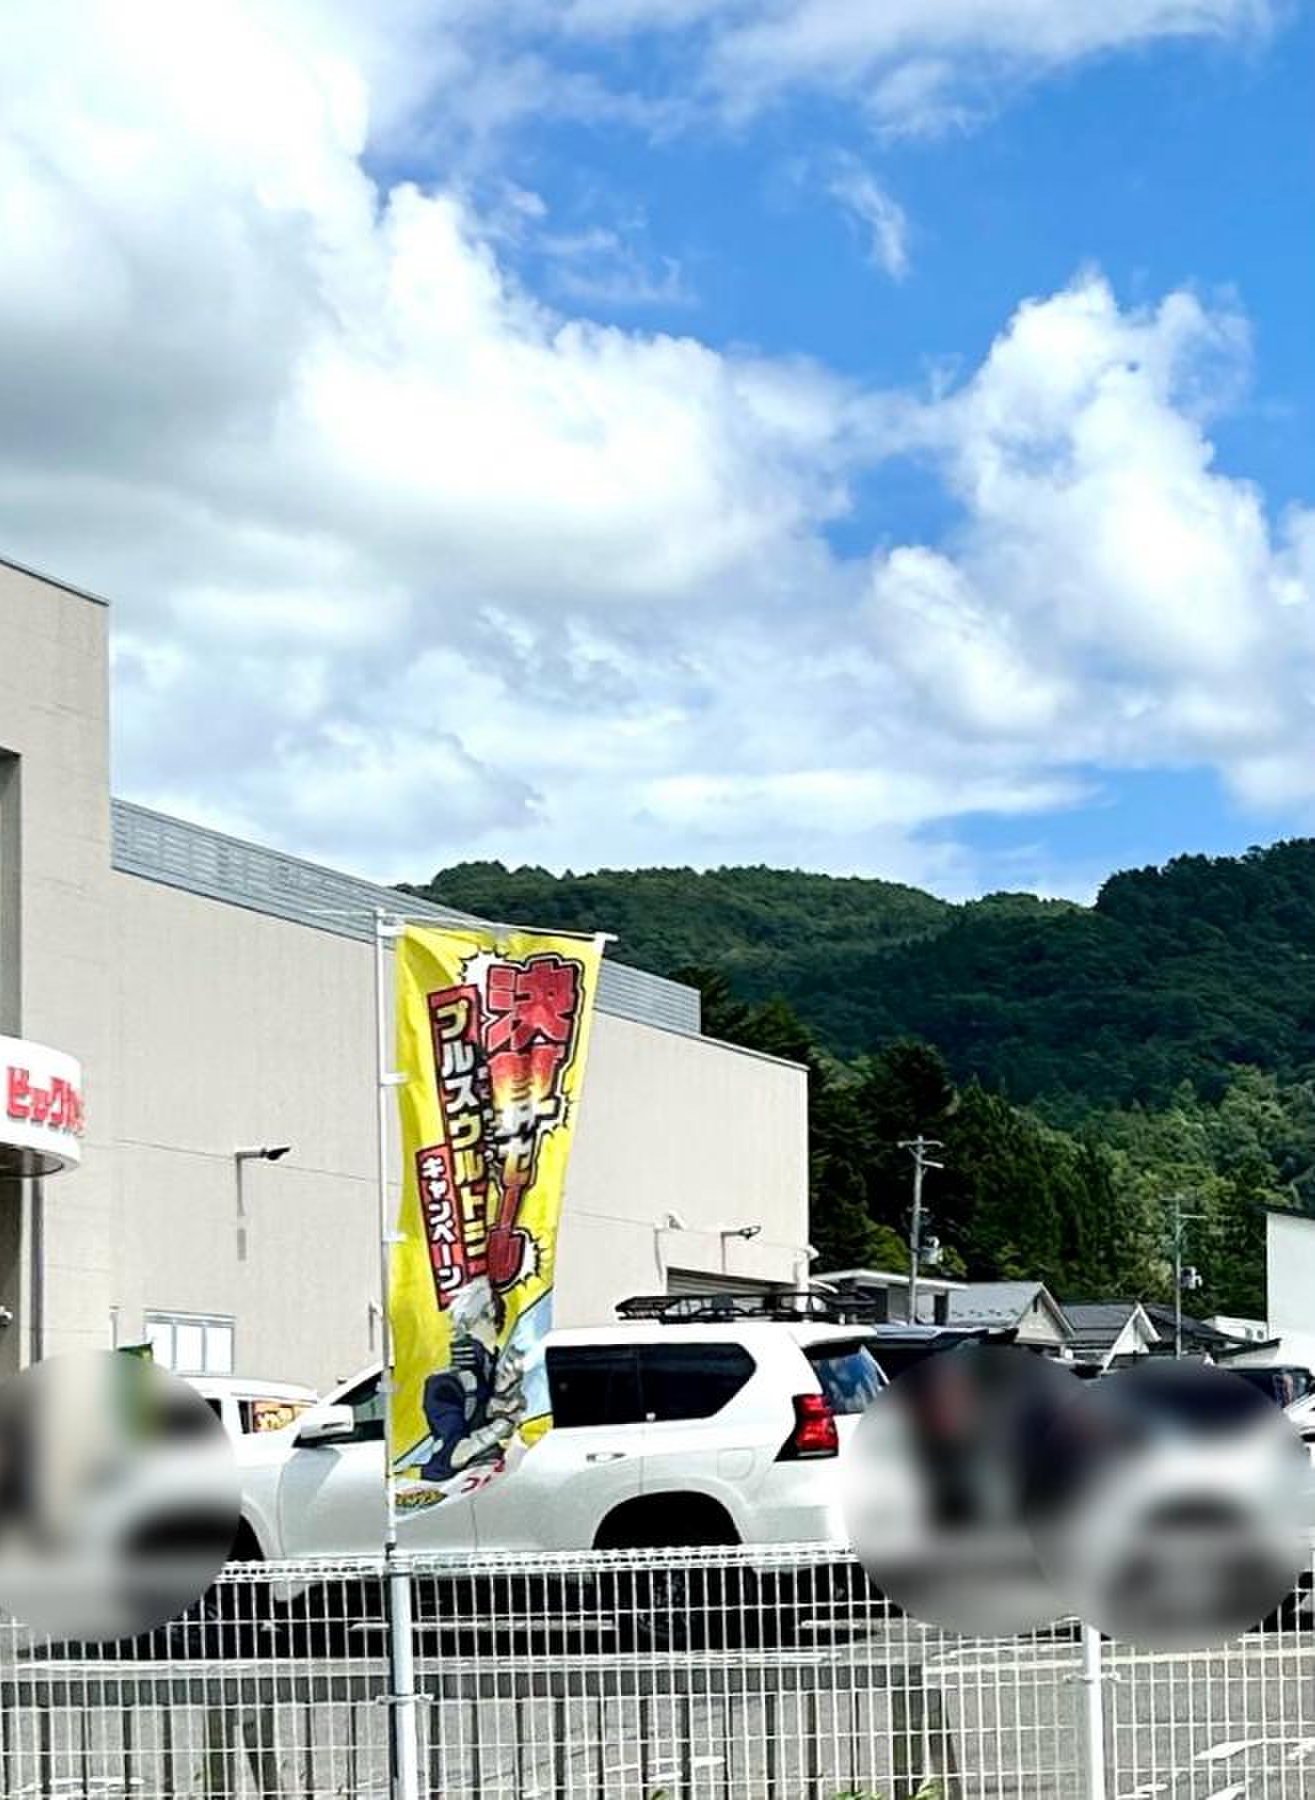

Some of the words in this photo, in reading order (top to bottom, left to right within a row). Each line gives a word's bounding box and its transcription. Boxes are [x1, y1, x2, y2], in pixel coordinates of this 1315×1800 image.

[421, 1155, 462, 1292] キャンペーン
